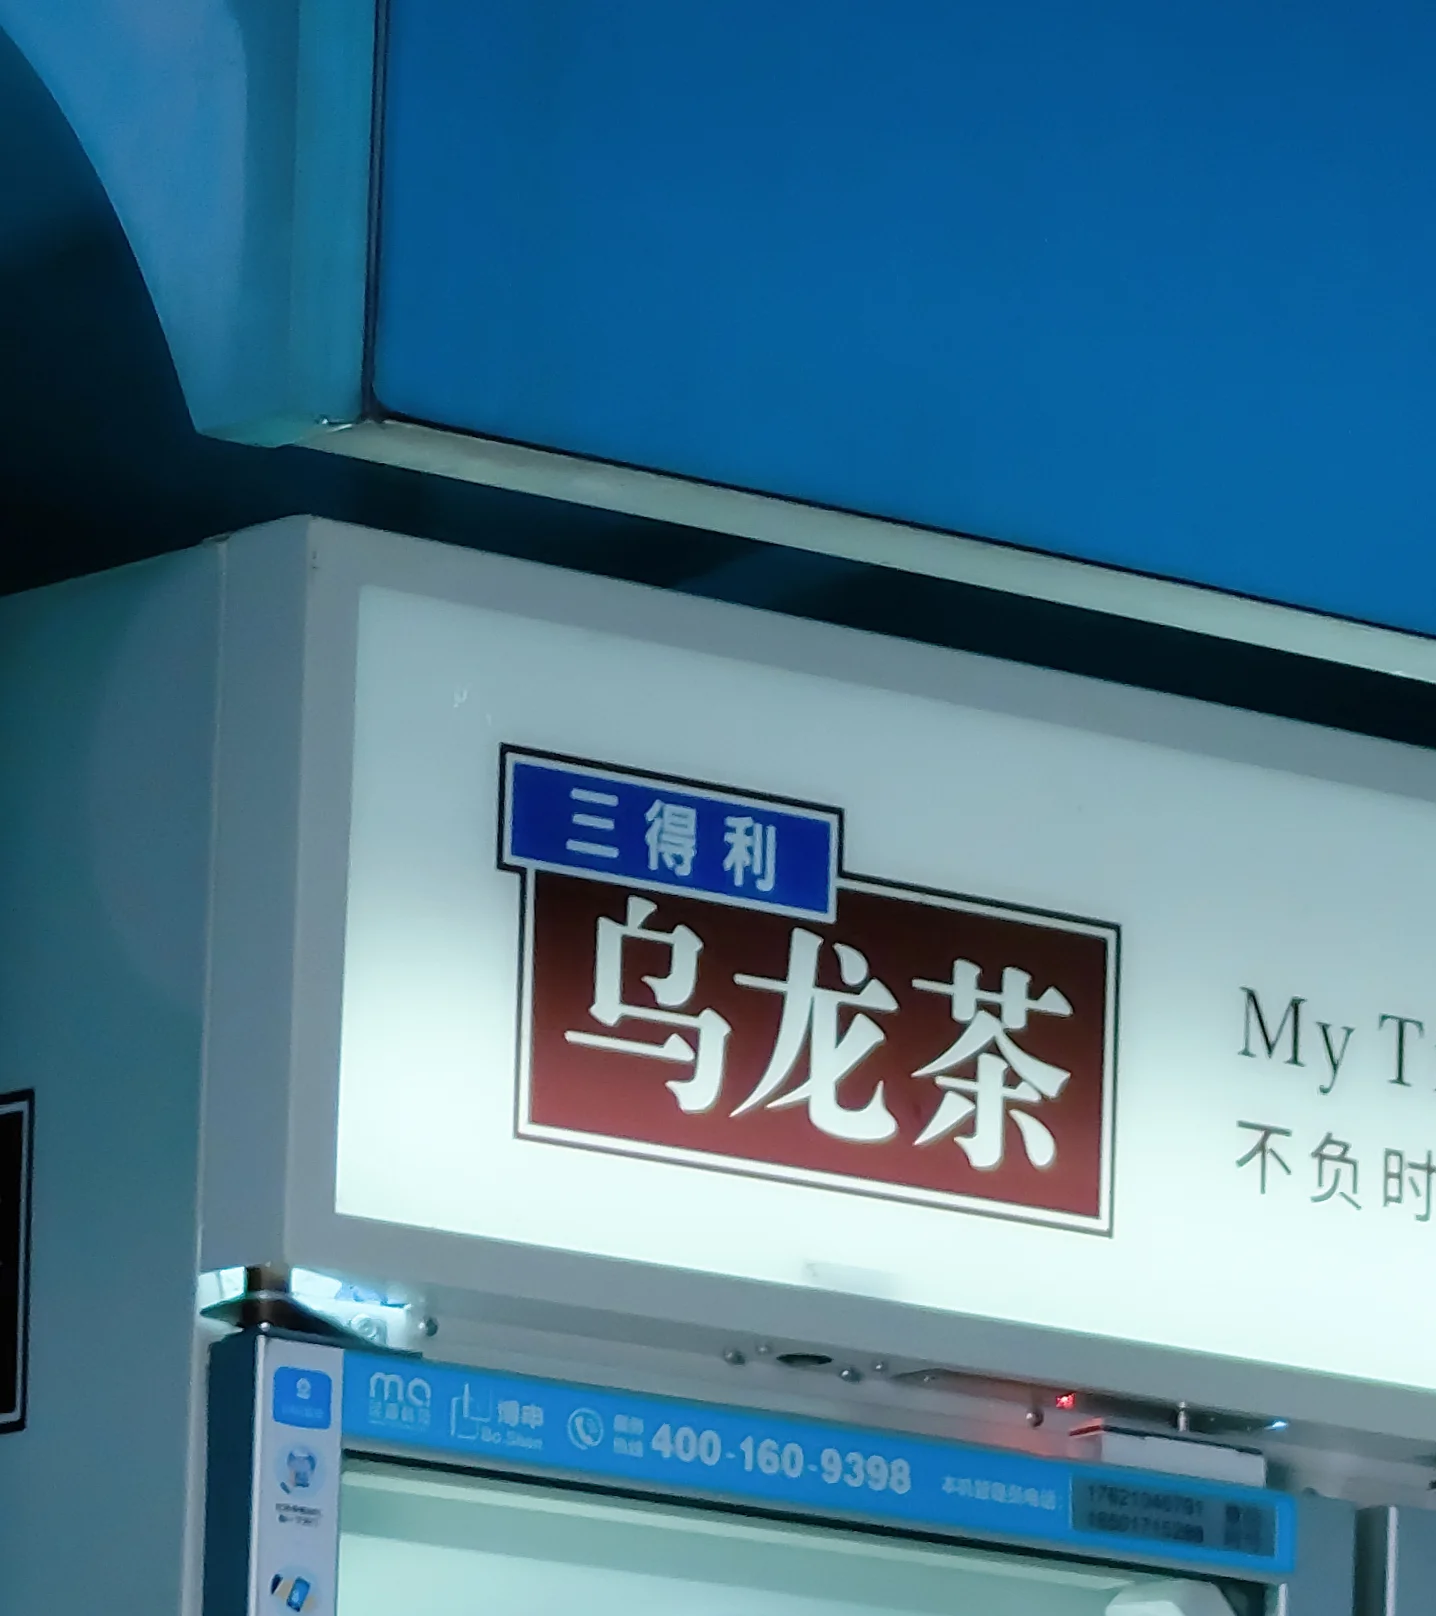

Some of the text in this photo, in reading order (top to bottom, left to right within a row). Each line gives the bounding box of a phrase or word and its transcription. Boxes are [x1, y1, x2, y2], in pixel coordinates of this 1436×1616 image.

[566, 788, 777, 893] 三得利
[564, 896, 1074, 1171] 乌龙茶
[1238, 986, 1354, 1092] My
[652, 1422, 911, 1494] 400-160-9398
